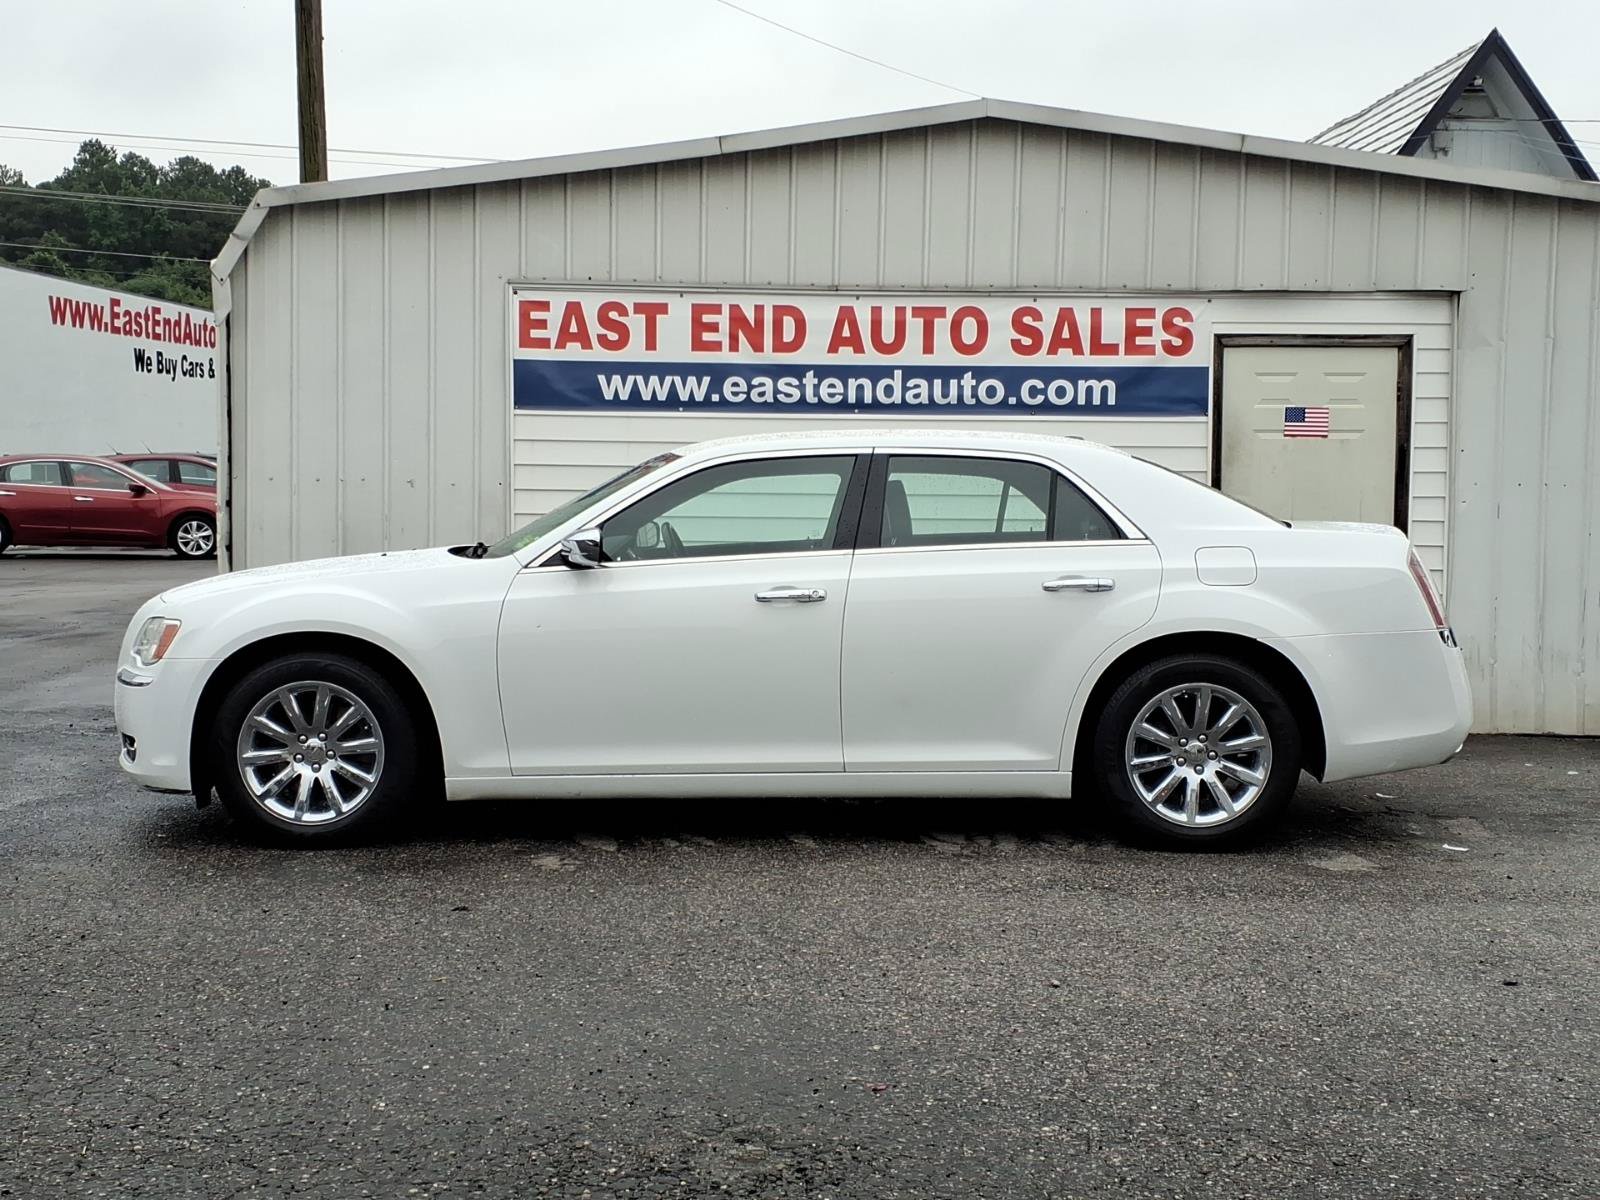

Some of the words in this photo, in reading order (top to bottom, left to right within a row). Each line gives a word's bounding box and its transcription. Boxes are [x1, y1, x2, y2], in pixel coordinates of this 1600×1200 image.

[518, 299, 670, 352] EAST
[690, 302, 808, 354] END
[826, 305, 990, 356] AUTO
[1009, 306, 1195, 357] SALES
[133, 347, 153, 374] We
[156, 350, 178, 382] Buy
[180, 354, 205, 379] Cars
[207, 357, 216, 379] &
[597, 369, 1117, 406] www.eastendauto.com
